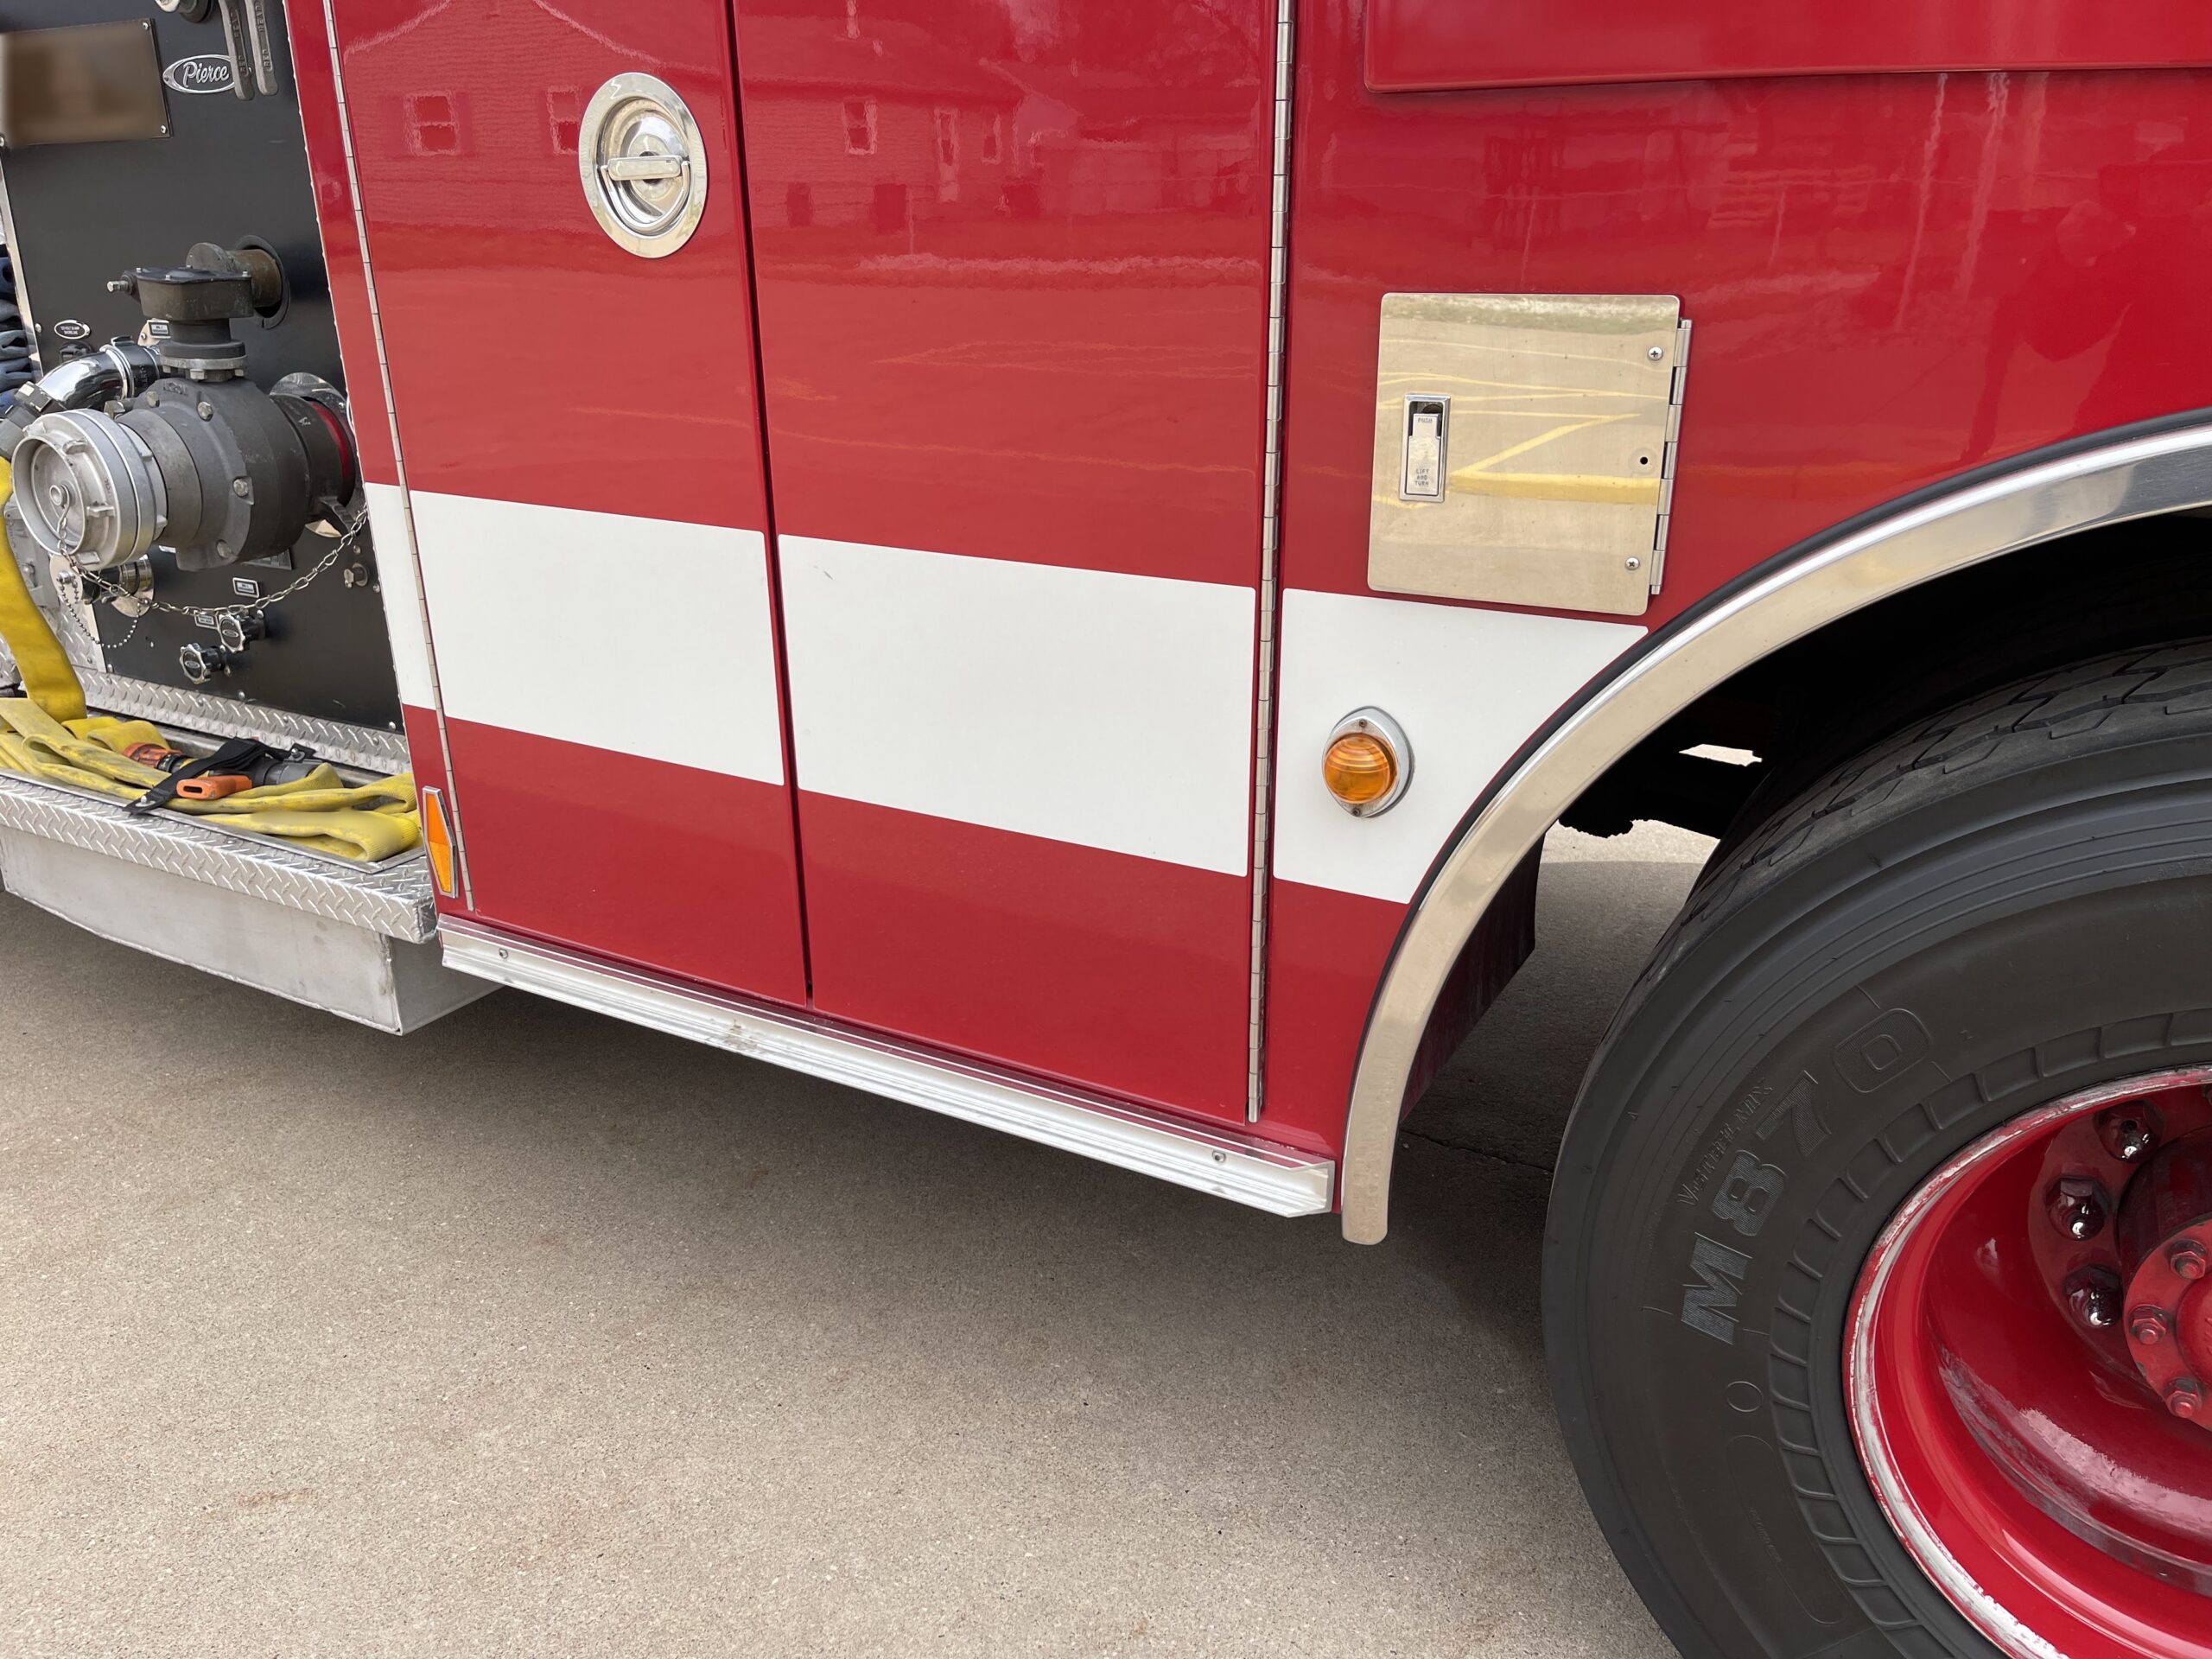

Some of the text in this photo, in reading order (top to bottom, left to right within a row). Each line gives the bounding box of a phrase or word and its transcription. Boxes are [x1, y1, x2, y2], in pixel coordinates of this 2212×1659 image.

[255, 3, 271, 69] RED HEAD
[182, 61, 230, 87] Pierce
[1681, 1007, 1933, 1345] M870
